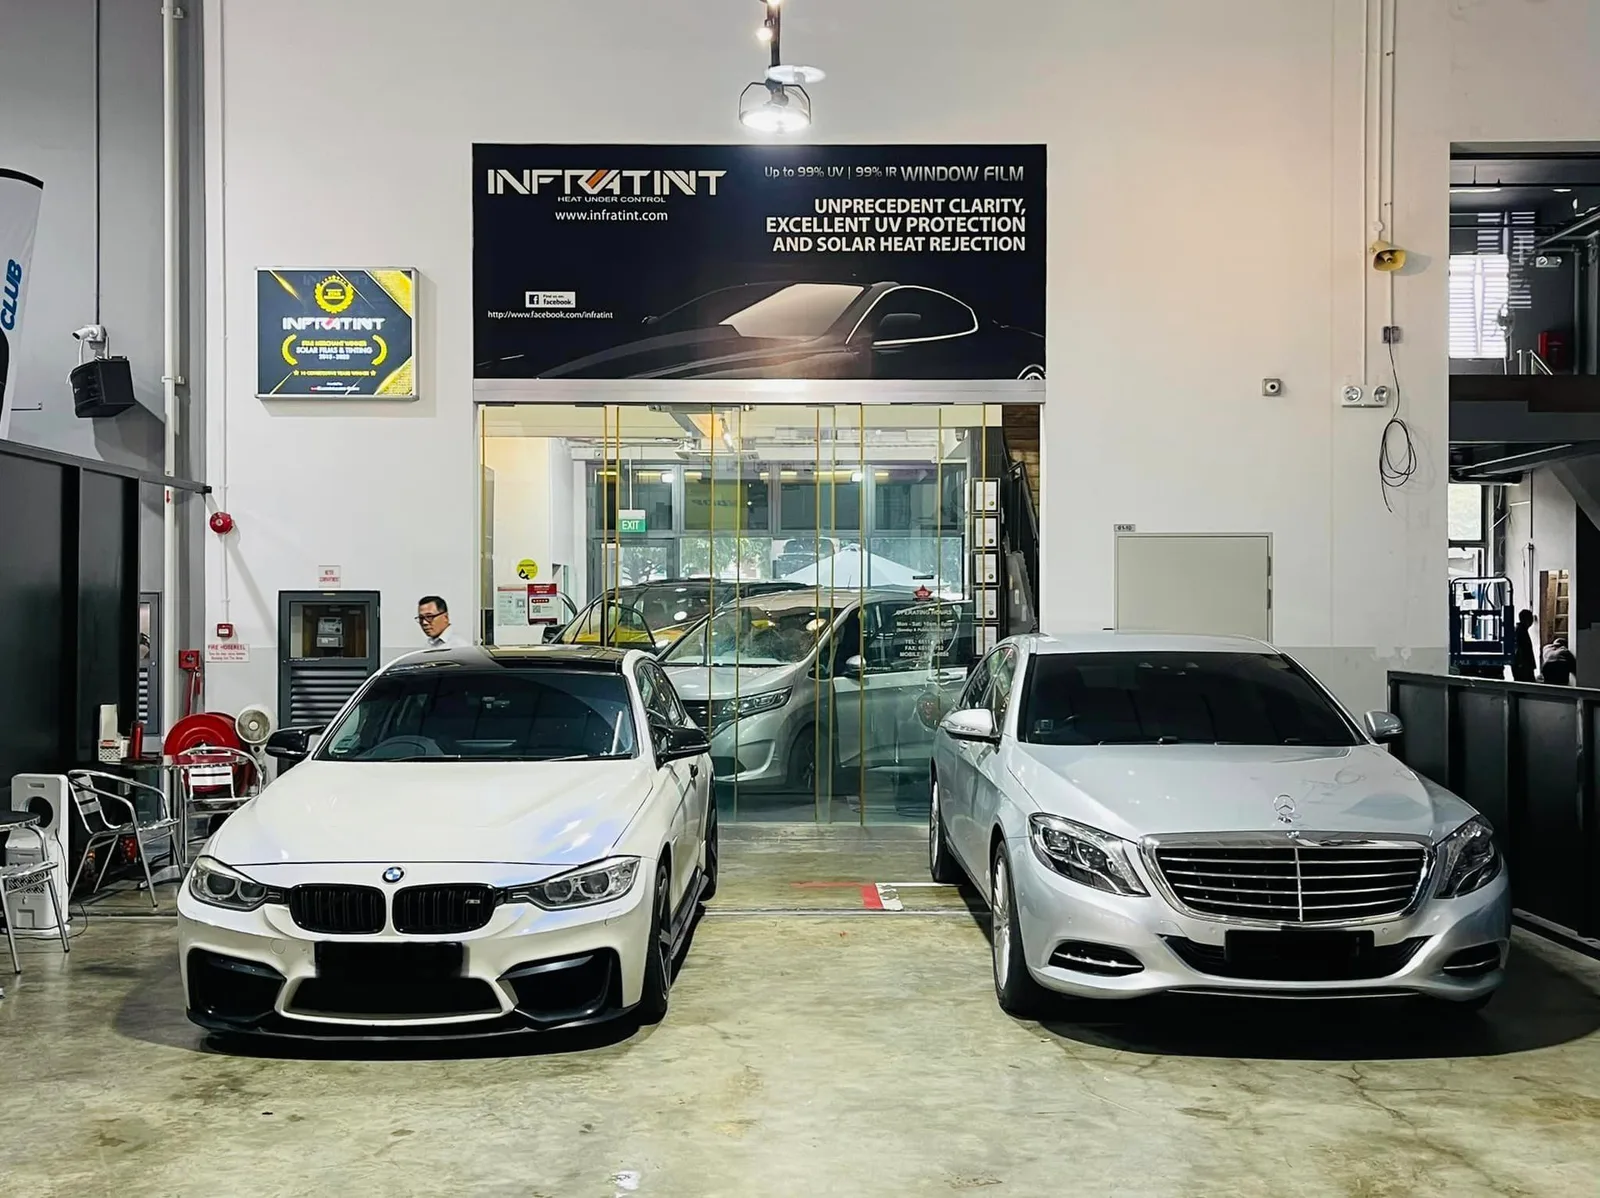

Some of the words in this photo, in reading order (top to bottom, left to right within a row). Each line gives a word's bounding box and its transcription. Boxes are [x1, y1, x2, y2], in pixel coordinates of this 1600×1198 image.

[765, 166, 779, 180] Up
[783, 166, 794, 177] to
[798, 166, 824, 177] 99%
[828, 166, 844, 177] UV
[855, 166, 882, 177] 99%
[886, 166, 897, 177] IR
[900, 166, 979, 182] WINDOW
[984, 166, 1024, 182] FILM
[488, 169, 727, 196] INFRATINT
[815, 198, 945, 214] UNPRECEDENT
[949, 198, 1026, 216] CLARITY,
[555, 209, 668, 222] www.infratint.com
[766, 217, 870, 233] EXCELLENT
[875, 217, 901, 233] UV
[906, 217, 1026, 233] PROTECTION
[773, 236, 812, 252] AND
[817, 236, 875, 252] SOLAR
[880, 236, 925, 252] HEAT
[929, 236, 1026, 252] REJECTION
[0, 259, 23, 331] CLUB
[488, 310, 613, 321] http://www.facebook.com/infratint
[296, 346, 318, 354] SOLAR
[622, 520, 639, 530] EXIT
